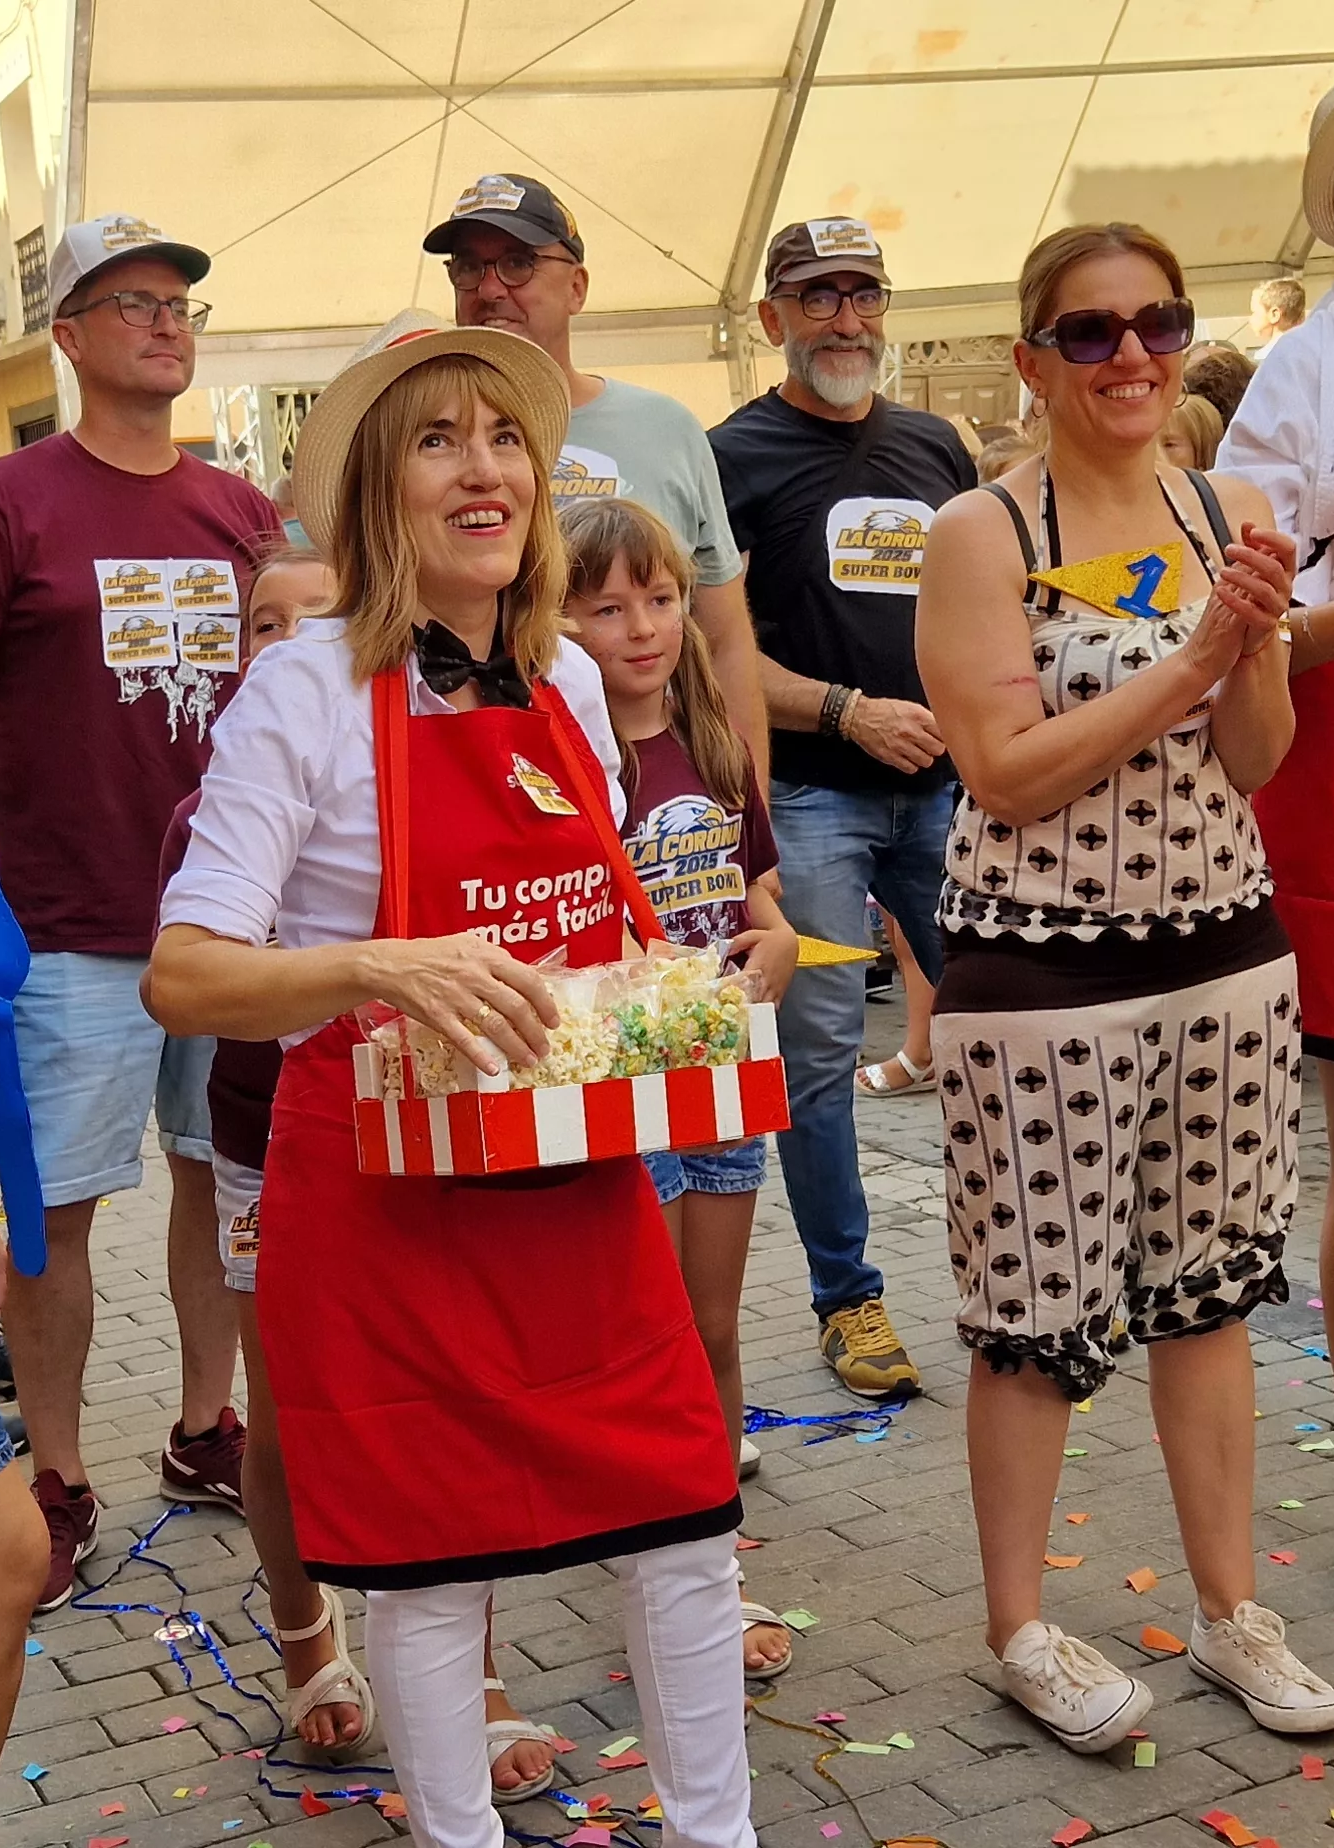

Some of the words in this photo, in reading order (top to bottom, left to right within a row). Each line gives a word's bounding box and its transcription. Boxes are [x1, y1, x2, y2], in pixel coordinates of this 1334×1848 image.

[837, 530, 864, 548] LA
[870, 549, 914, 563] 2025
[118, 573, 161, 587] CORONA
[840, 563, 890, 578] SUPER
[1116, 554, 1169, 620] 1
[627, 842, 659, 867] LA
[660, 823, 742, 861] CORONA
[674, 852, 718, 877] 2025
[460, 879, 507, 911] Tu
[646, 878, 703, 907] UPER
[707, 873, 739, 893] BOWL
